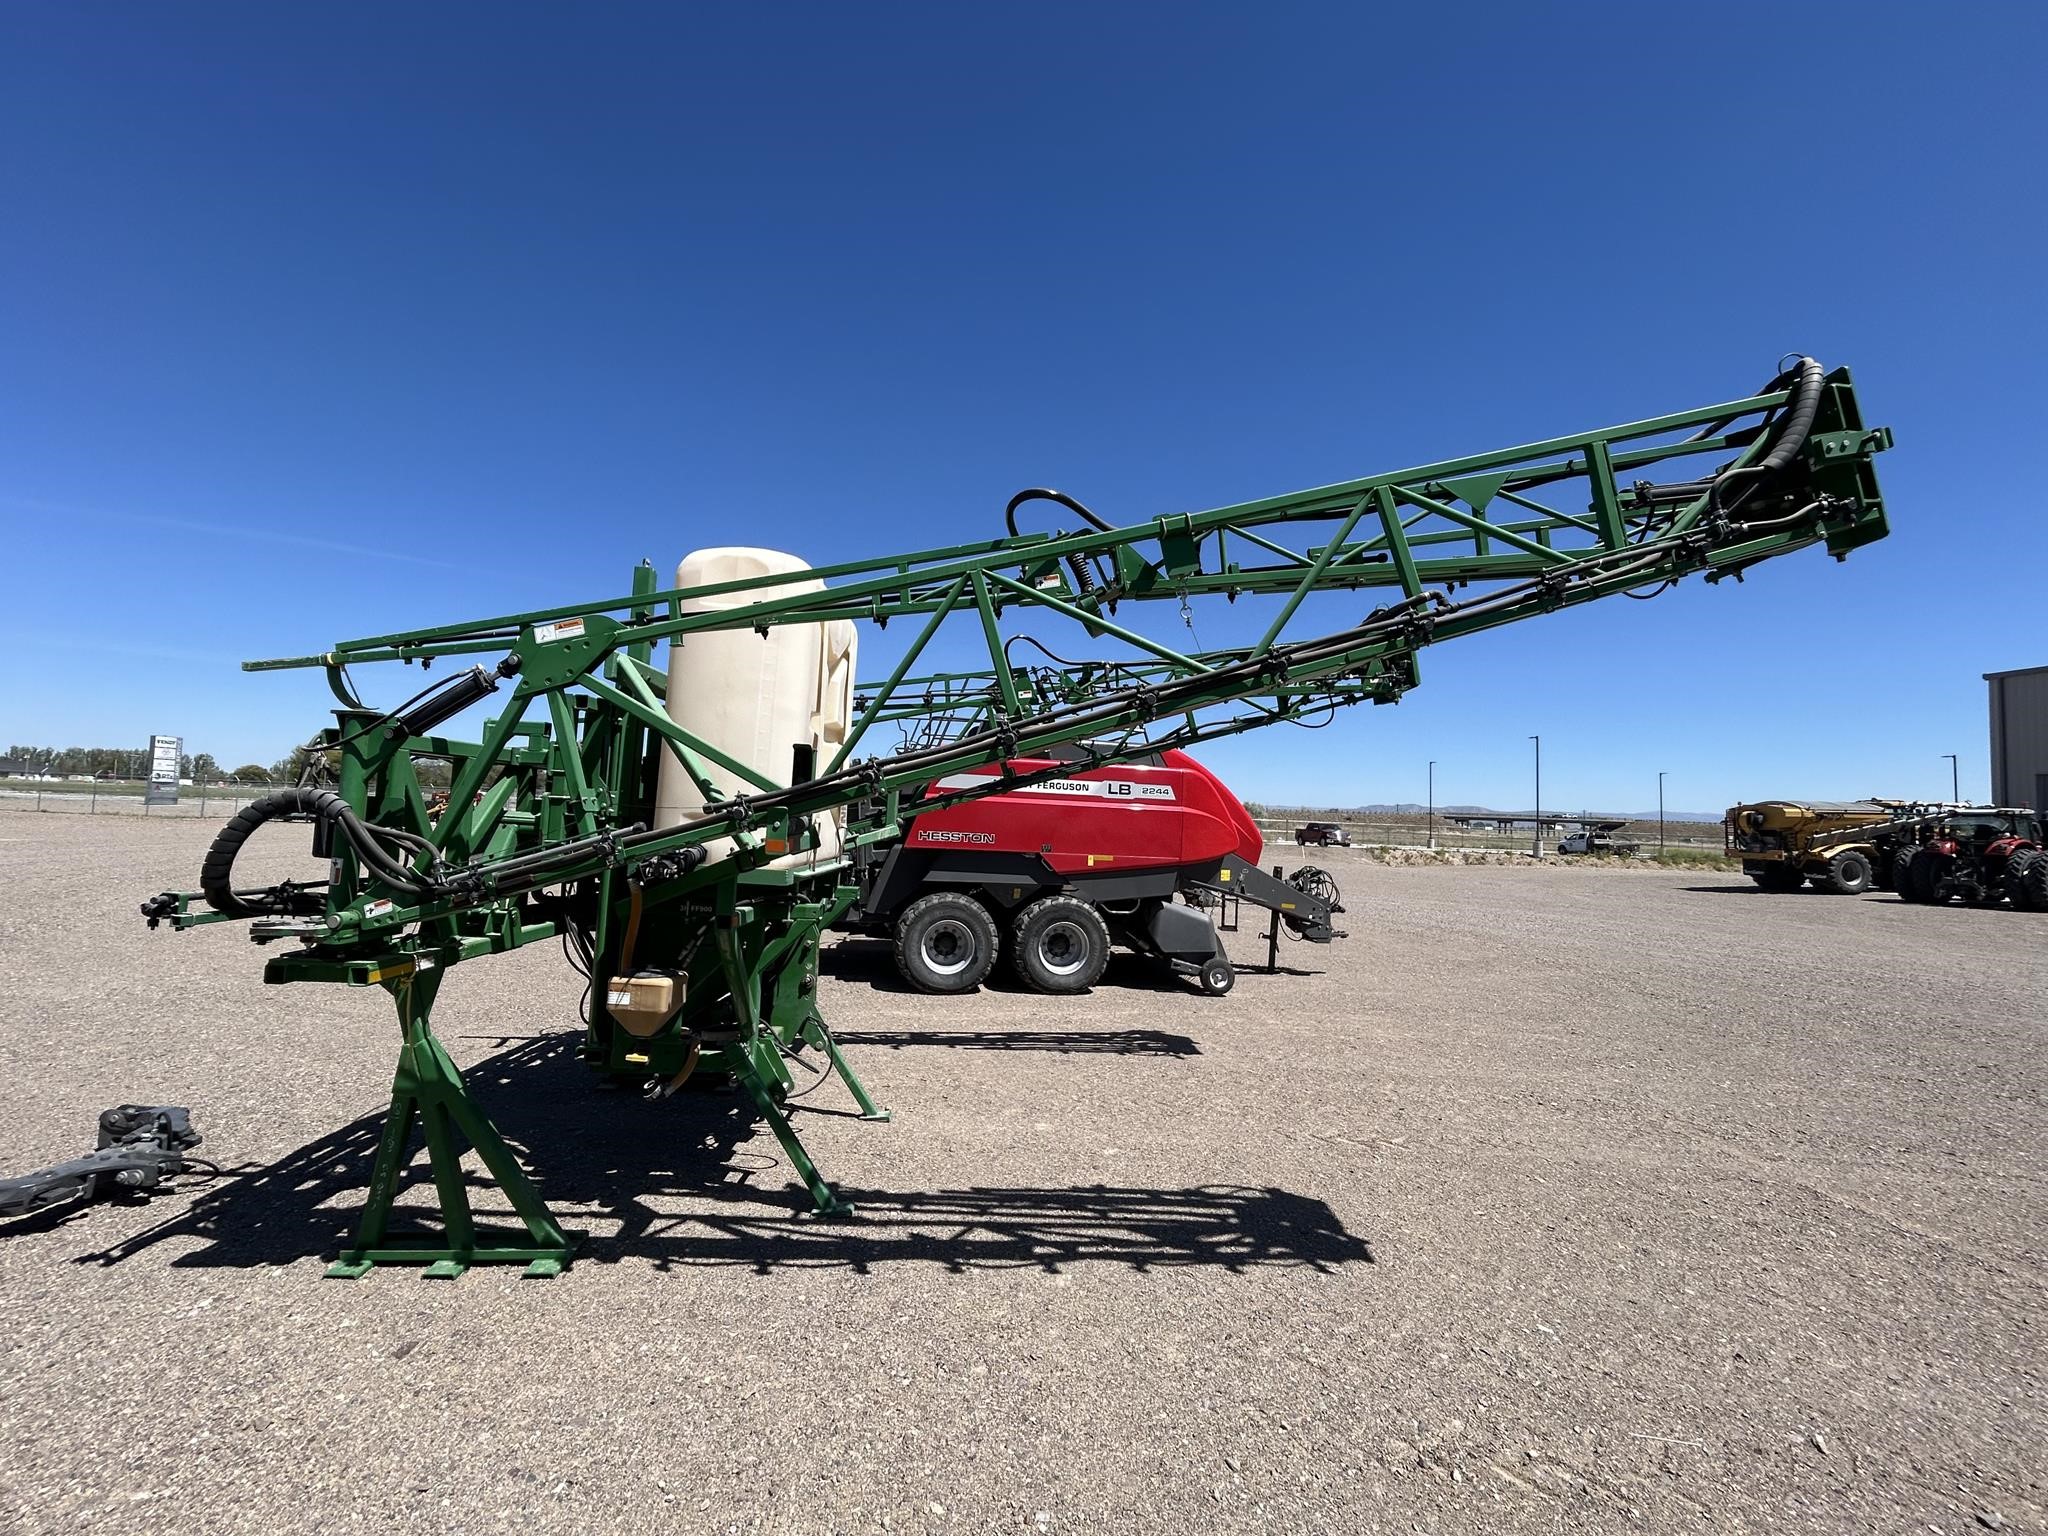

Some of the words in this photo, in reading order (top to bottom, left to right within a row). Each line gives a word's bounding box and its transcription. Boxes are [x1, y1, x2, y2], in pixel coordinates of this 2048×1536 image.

[1037, 781, 1089, 792] FERGUSON
[1107, 783, 1132, 796] LB
[1141, 787, 1169, 796] 2244
[918, 830, 995, 844] HESSTON
